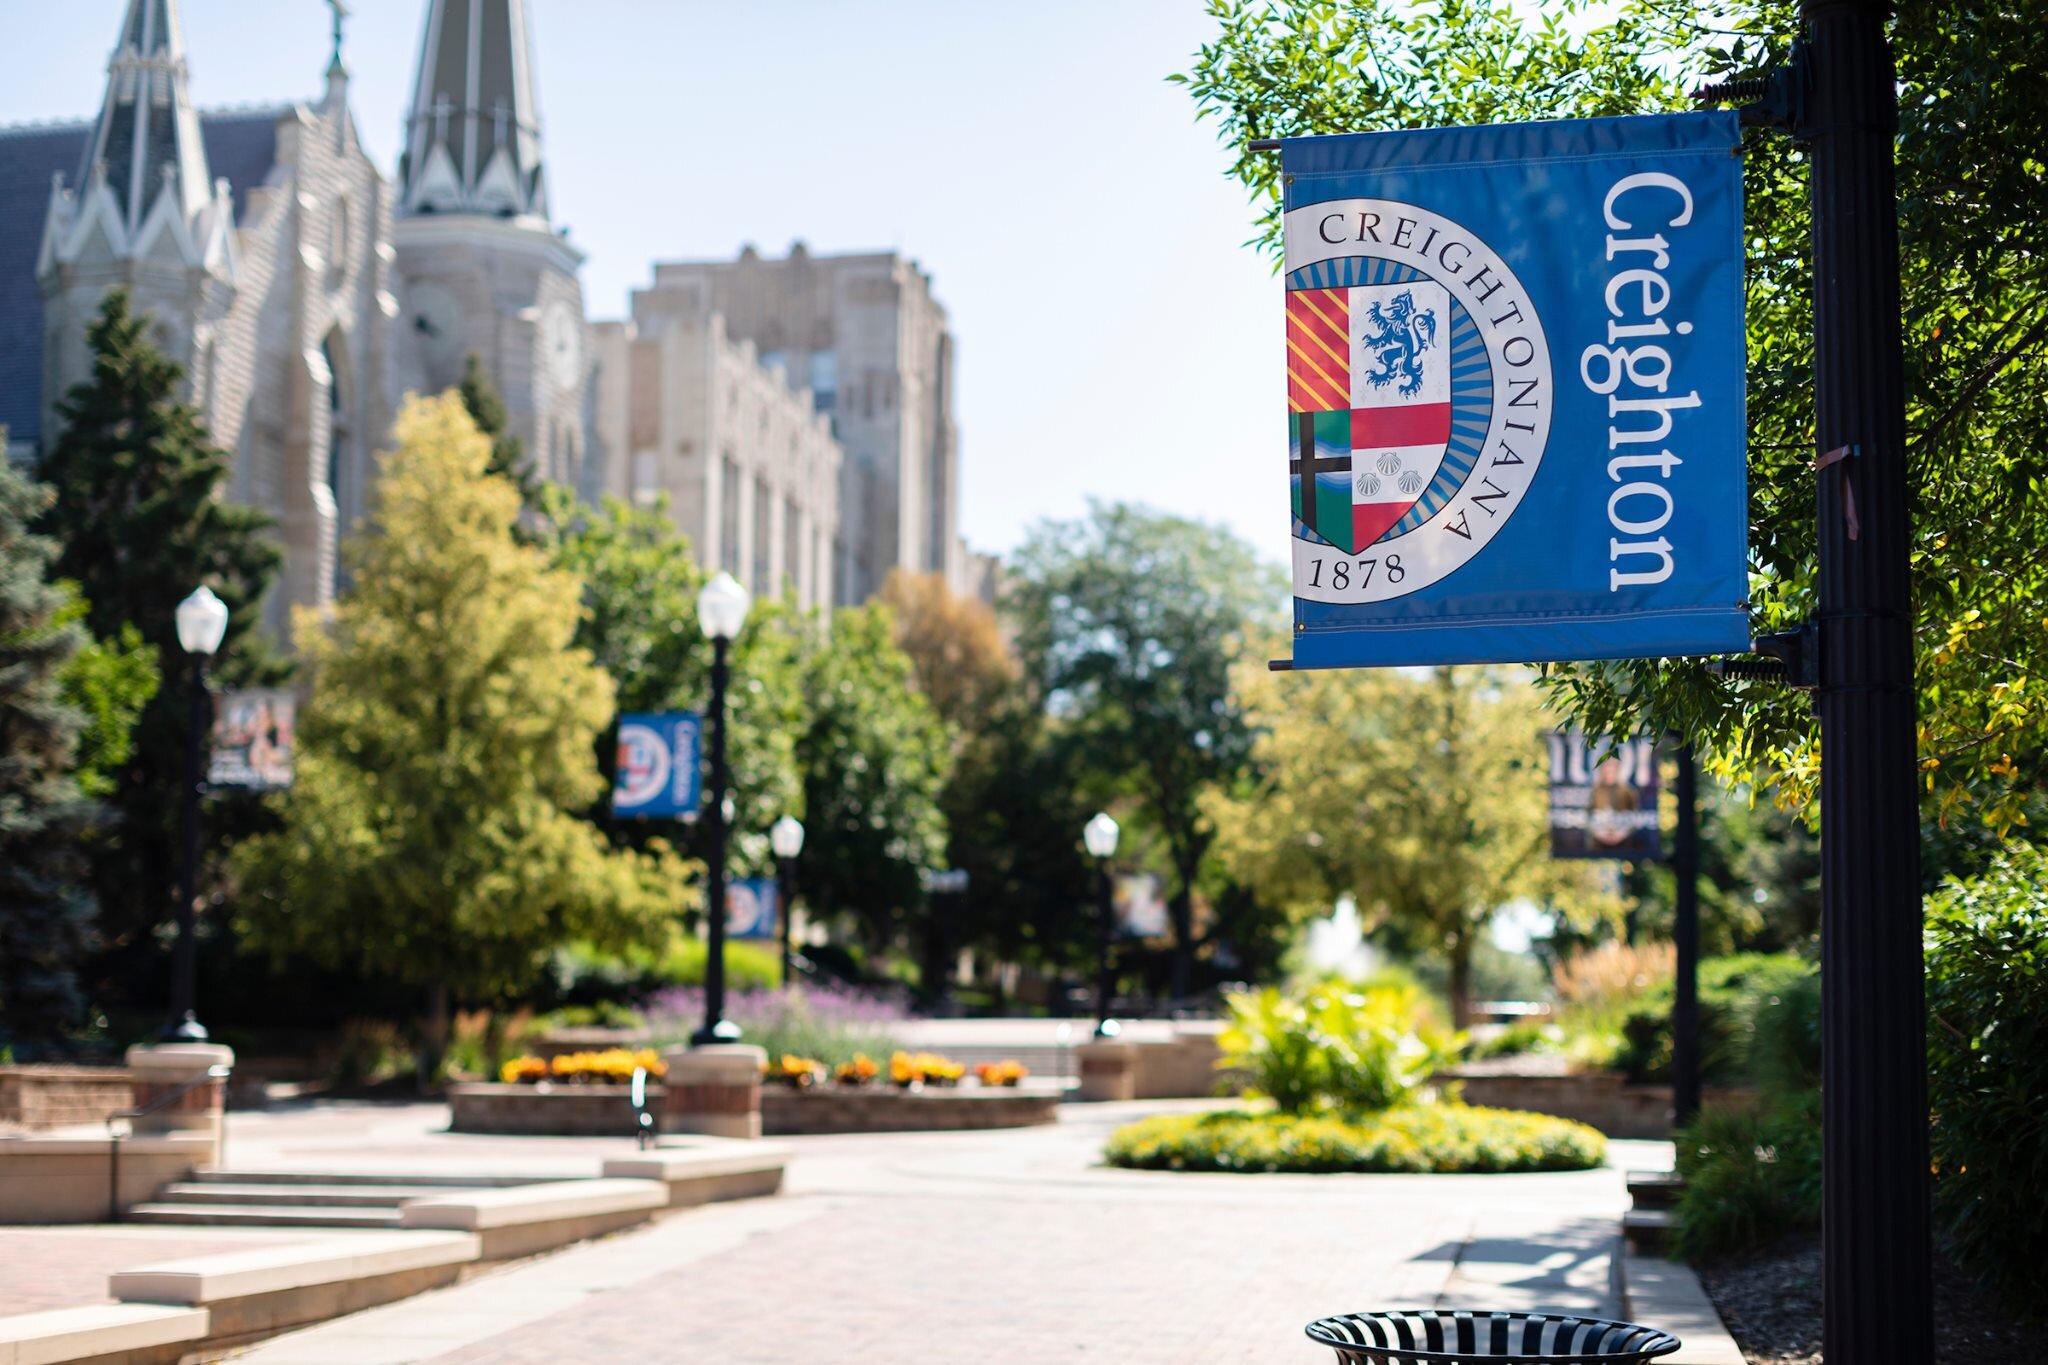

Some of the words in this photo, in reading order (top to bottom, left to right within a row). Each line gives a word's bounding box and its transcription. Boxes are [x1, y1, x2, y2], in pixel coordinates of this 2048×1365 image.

[1319, 212, 1538, 542] CREIGHTONIANA
[1580, 171, 1702, 592] Creighton
[1308, 554, 1406, 590] 1878
